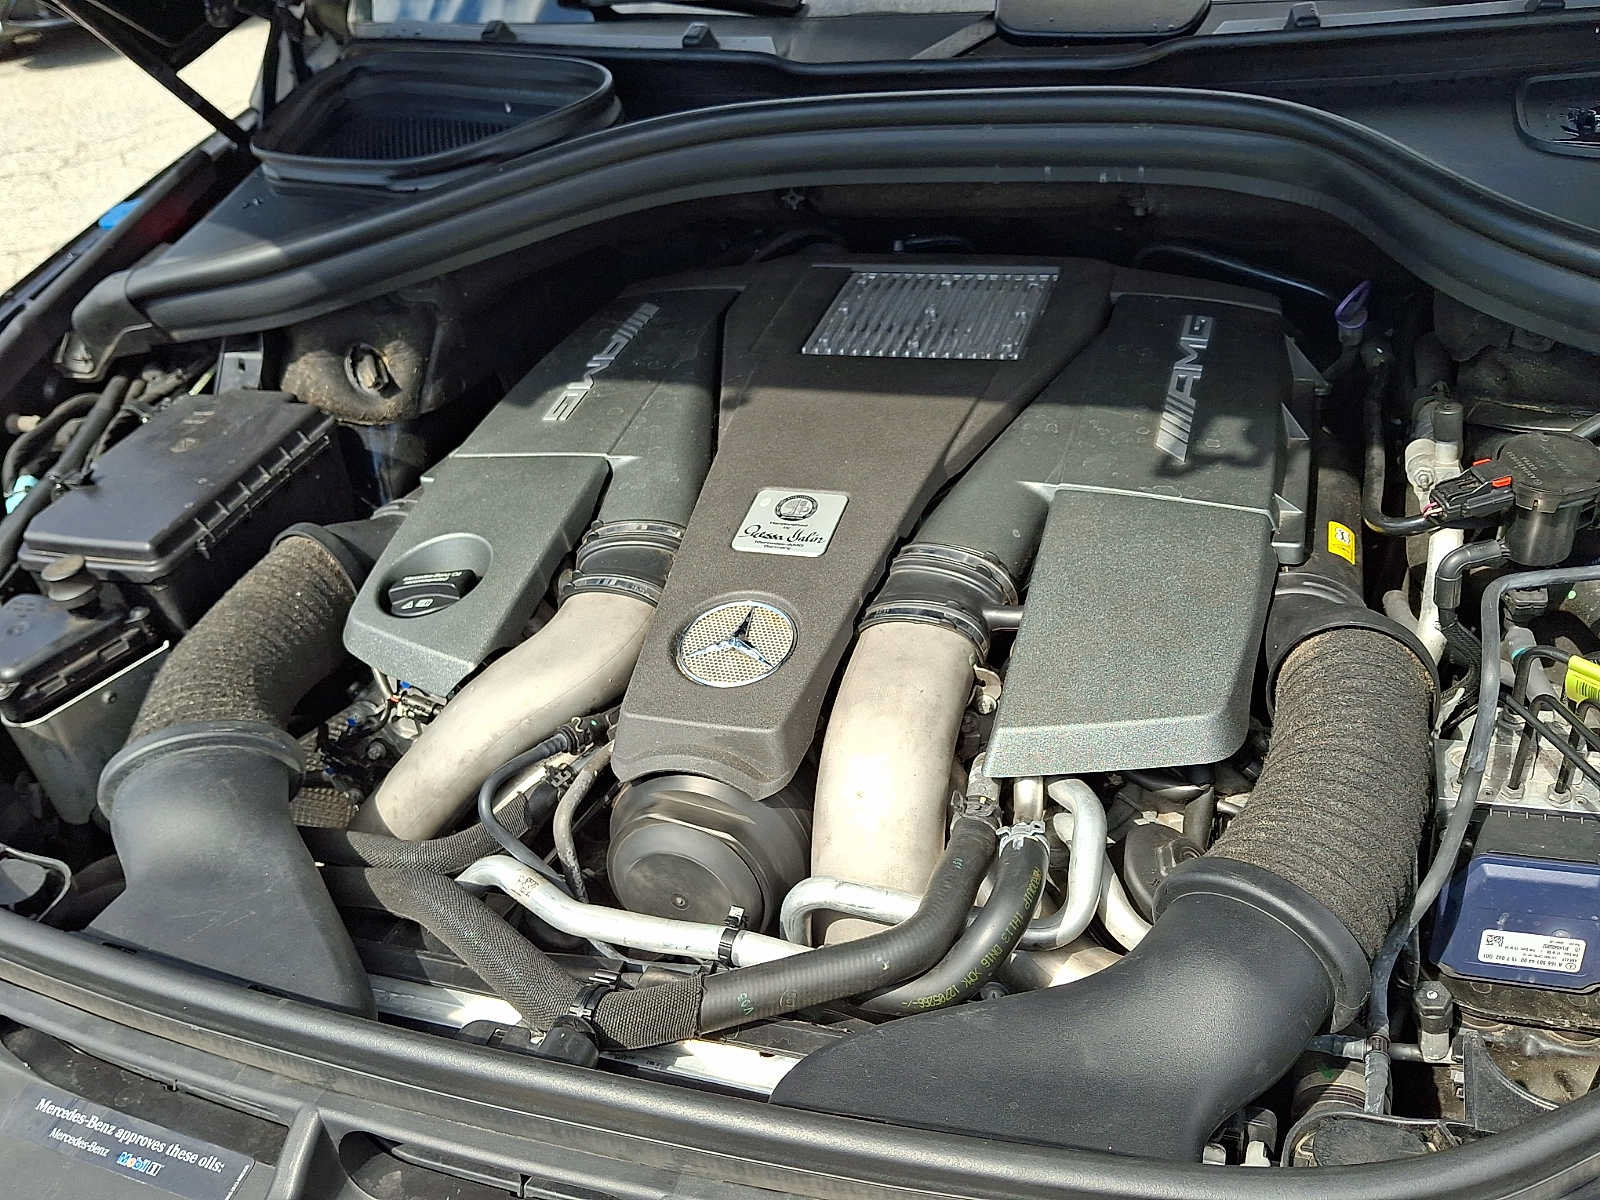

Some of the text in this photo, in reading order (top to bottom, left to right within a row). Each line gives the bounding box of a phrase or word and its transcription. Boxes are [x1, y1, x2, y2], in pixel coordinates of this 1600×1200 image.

[35, 1098, 225, 1173] Mercedes-Benz approves these oils:
[49, 1127, 110, 1158] Mercedes-Benz
